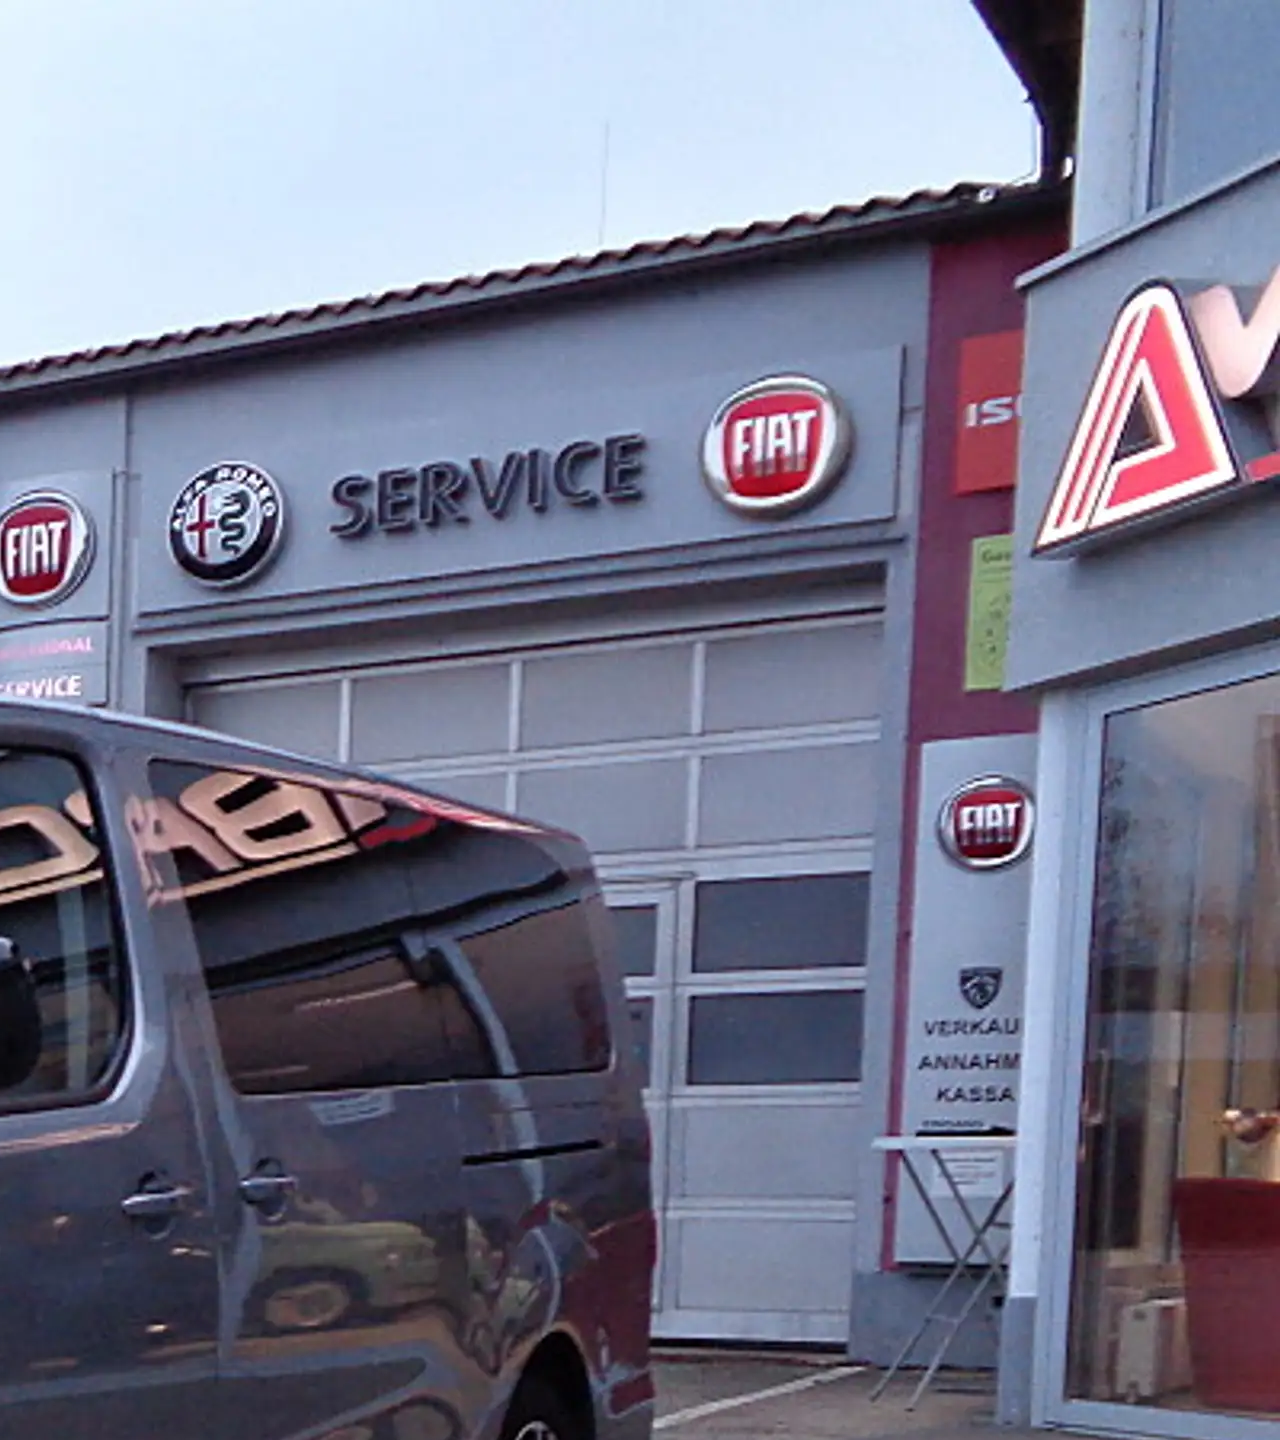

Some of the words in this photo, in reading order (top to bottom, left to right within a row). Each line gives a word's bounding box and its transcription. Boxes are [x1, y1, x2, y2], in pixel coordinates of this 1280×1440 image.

[732, 409, 817, 479] FIAT
[329, 433, 647, 538] SERVICE
[5, 520, 68, 580] FIAT
[960, 802, 1022, 845] FIAT
[936, 1087, 1016, 1102] KASSA
